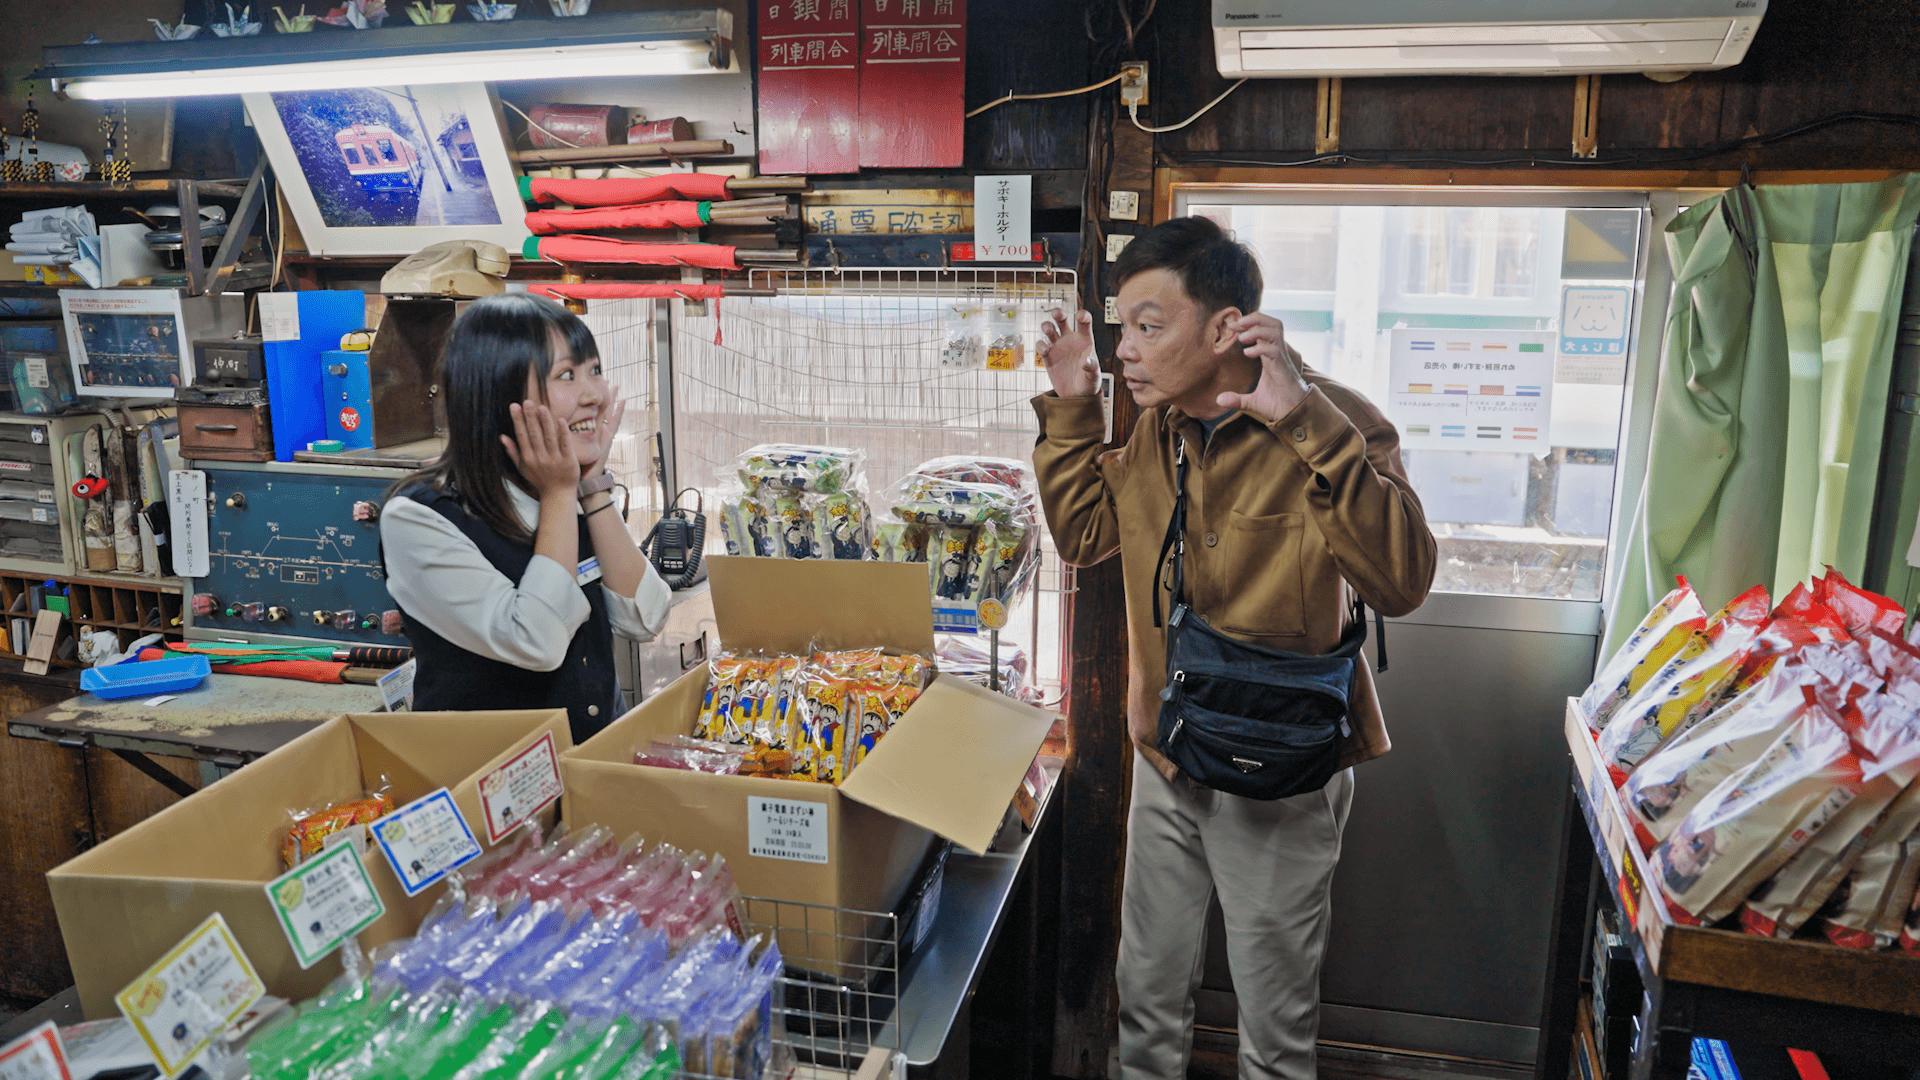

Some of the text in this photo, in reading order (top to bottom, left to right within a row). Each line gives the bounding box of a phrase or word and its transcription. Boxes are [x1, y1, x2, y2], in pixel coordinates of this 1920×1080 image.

[770, 40, 849, 64] 列車間合
[870, 29, 958, 56] 列車間合
